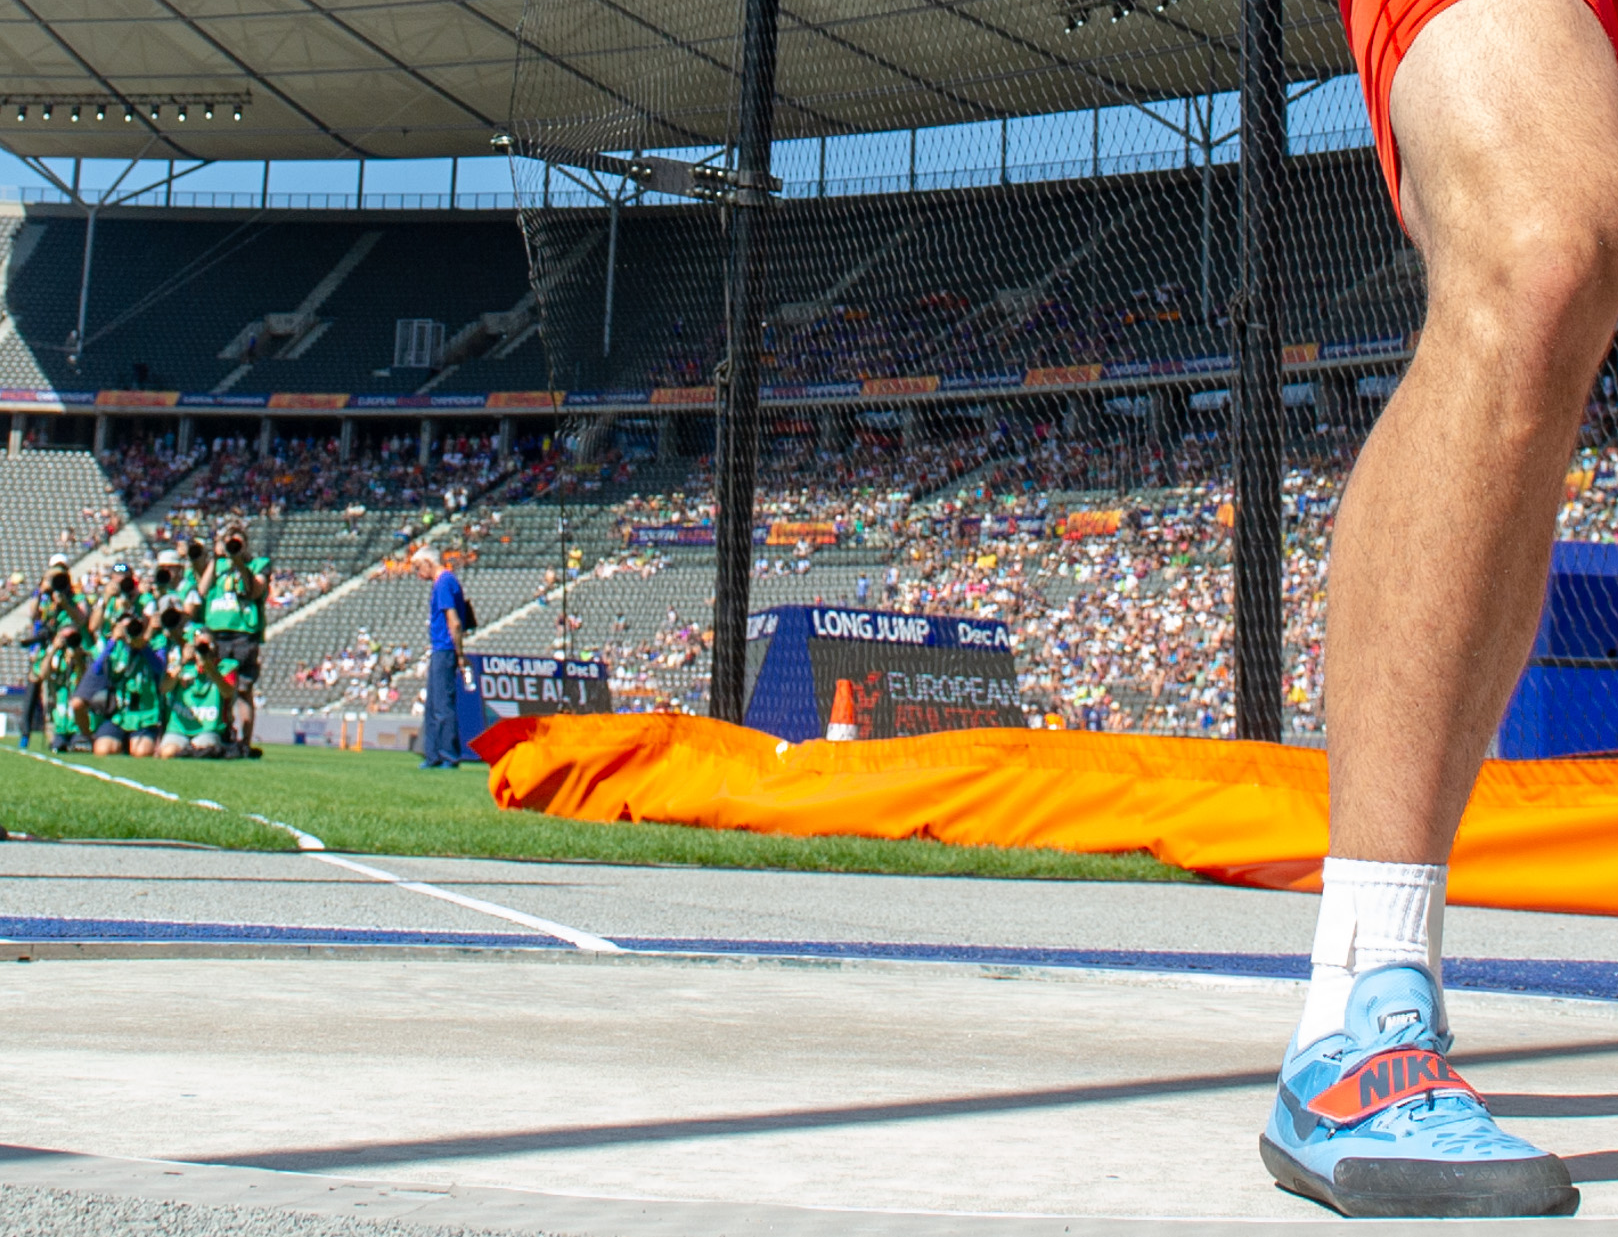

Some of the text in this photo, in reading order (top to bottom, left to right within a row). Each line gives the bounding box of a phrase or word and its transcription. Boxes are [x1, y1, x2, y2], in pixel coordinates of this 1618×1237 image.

[813, 609, 1011, 647] LONG JUMP Dec A
[482, 656, 521, 675] LONG
[522, 659, 558, 678] JUMP
[566, 662, 588, 677] Dec
[480, 674, 539, 701] DOLE
[888, 671, 1020, 706] EUROPEAN
[1360, 1054, 1461, 1109] NIKE
